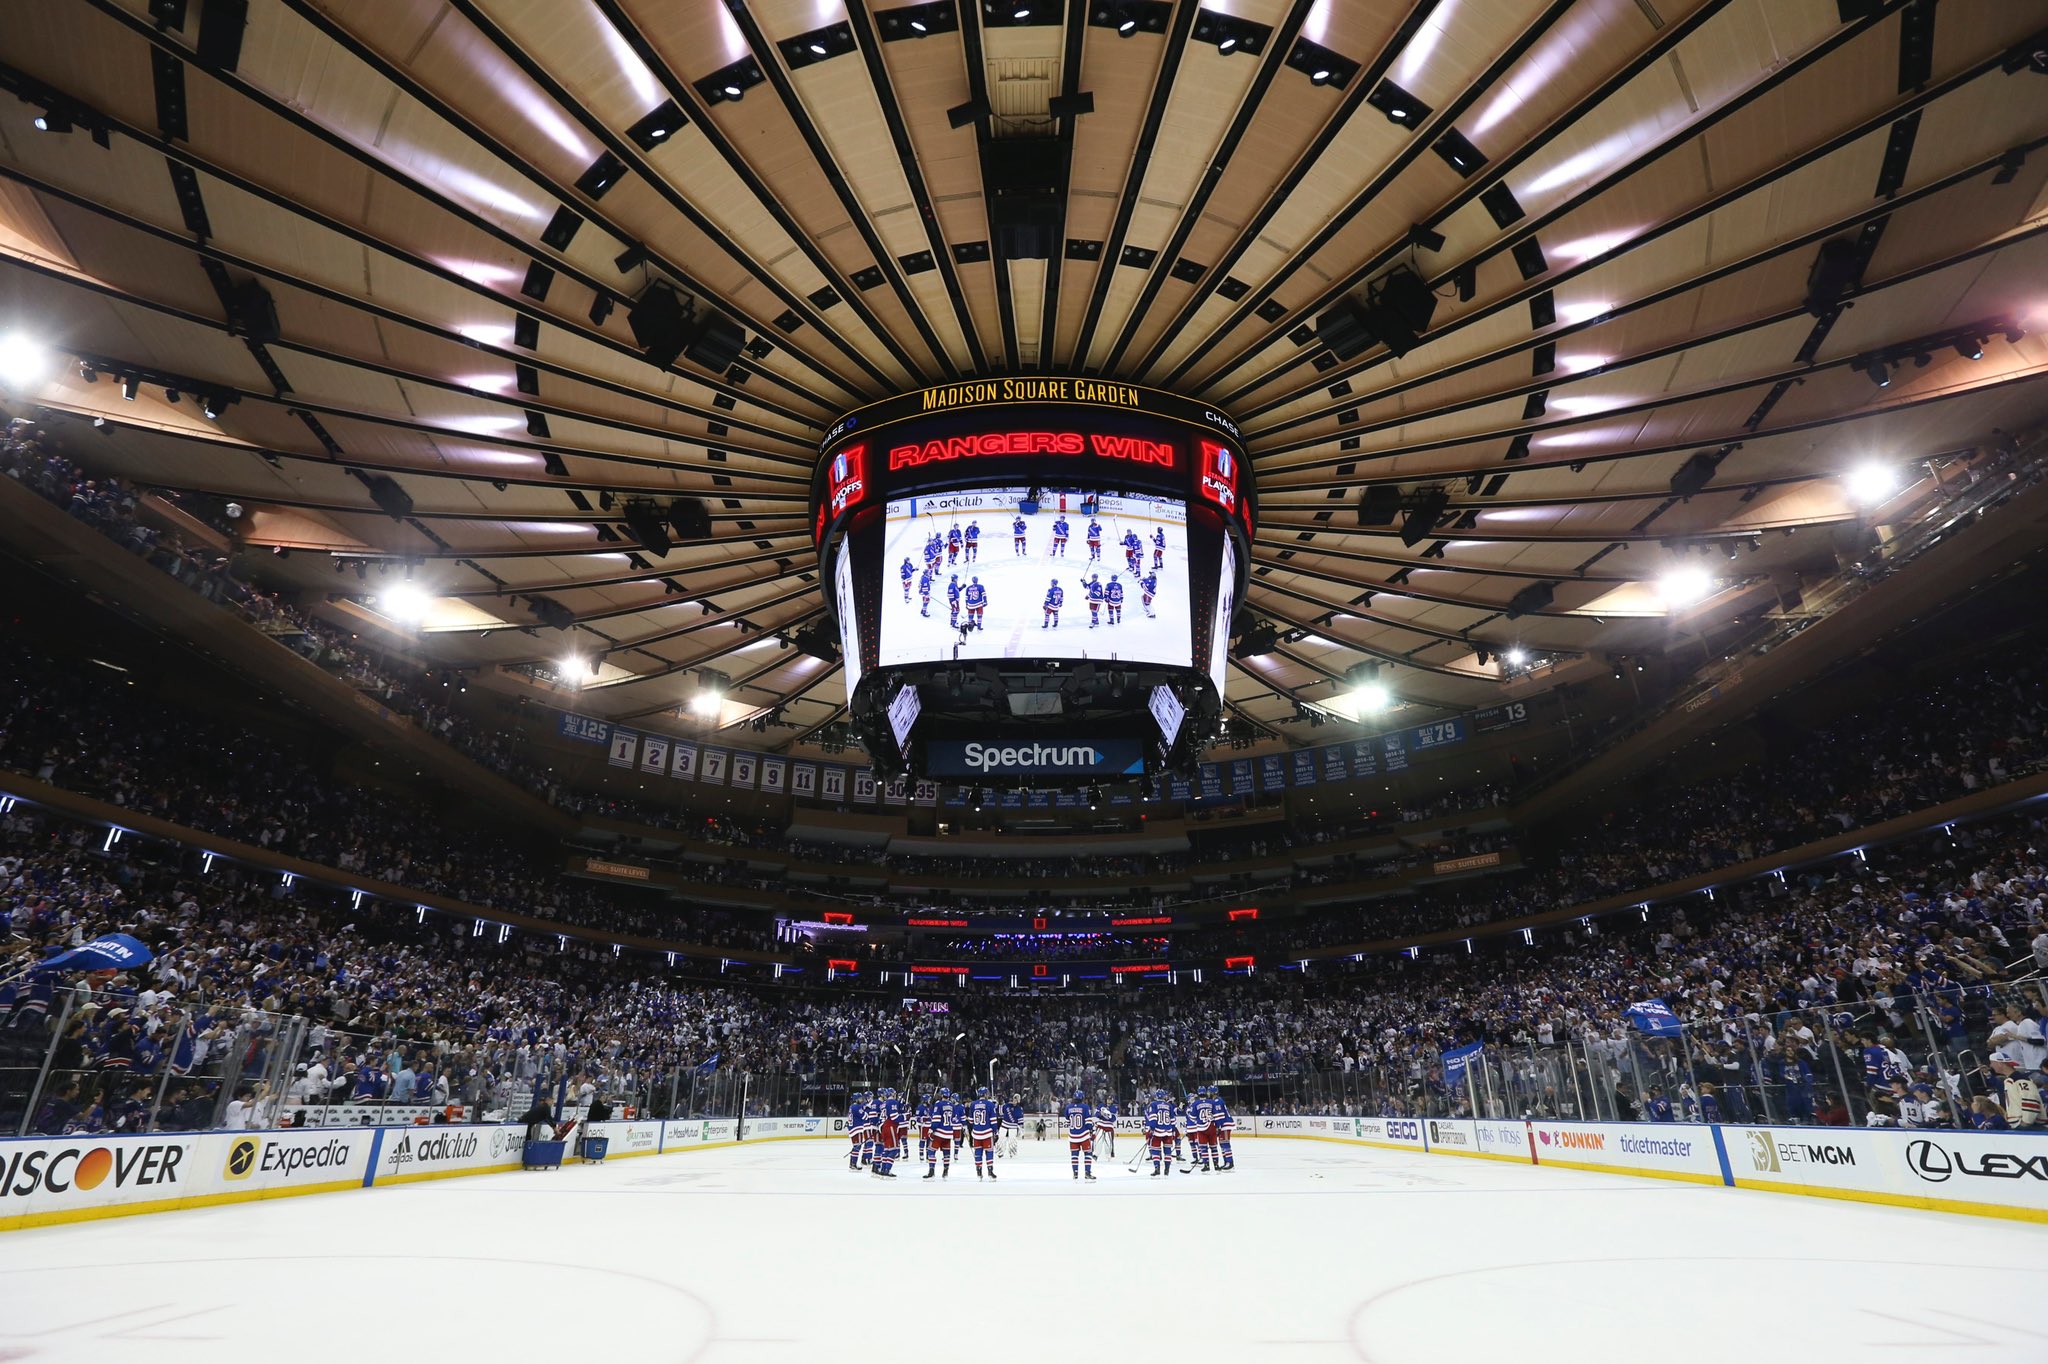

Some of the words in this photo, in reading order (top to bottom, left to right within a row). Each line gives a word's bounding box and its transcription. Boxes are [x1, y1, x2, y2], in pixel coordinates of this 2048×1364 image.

[923, 383, 997, 410] MADISON
[1003, 379, 1068, 401] SQUARE
[1075, 379, 1139, 407] GARDEN
[1205, 410, 1240, 438] CHASE
[889, 433, 1085, 471] RANGERS
[1091, 434, 1174, 467] WIN
[1202, 475, 1235, 505] PLAYOFFS
[939, 496, 983, 509] adiclub
[1099, 497, 1123, 508] pepsi
[1475, 709, 1500, 721] PHISH
[1505, 702, 1527, 721] 13
[565, 714, 581, 726] BILLY
[564, 723, 578, 734] JOEL
[580, 719, 608, 741] 125
[1418, 727, 1434, 738] BILLY
[1435, 722, 1456, 742] 79
[1421, 736, 1435, 745] JOEL
[618, 742, 626, 759] 1
[649, 749, 660, 766] 2
[964, 742, 1095, 773] Spectrum
[679, 755, 690, 771] 3
[709, 759, 719, 776] 7
[739, 765, 750, 781] 9
[768, 769, 778, 785] 9
[796, 772, 810, 789] 11
[826, 777, 840, 793] 11
[857, 780, 874, 796] 19
[887, 782, 905, 798] 30
[917, 783, 935, 799] 35
[610, 866, 628, 875] SUITE
[629, 869, 647, 877] LEVEL
[1446, 1056, 1461, 1065] NO
[2018, 1081, 2030, 1091] 12
[973, 1109, 986, 1126] 61
[1157, 1109, 1171, 1126] 16
[1906, 1107, 1917, 1118] 13
[805, 1121, 817, 1130] SAP
[1070, 1113, 1083, 1130] 10
[1276, 1120, 1303, 1129] HYUNDAI
[1356, 1122, 1381, 1134] enterprise
[673, 1126, 699, 1138] MassMutual
[704, 1125, 728, 1137] enterprise
[1386, 1120, 1419, 1141] GEICO
[418, 1132, 478, 1162] adiclub
[1561, 1131, 1605, 1150] DUNKIN'
[1620, 1133, 1692, 1157] ticketmaster
[260, 1136, 350, 1176] Expedia
[1778, 1142, 1857, 1166] BETMGM
